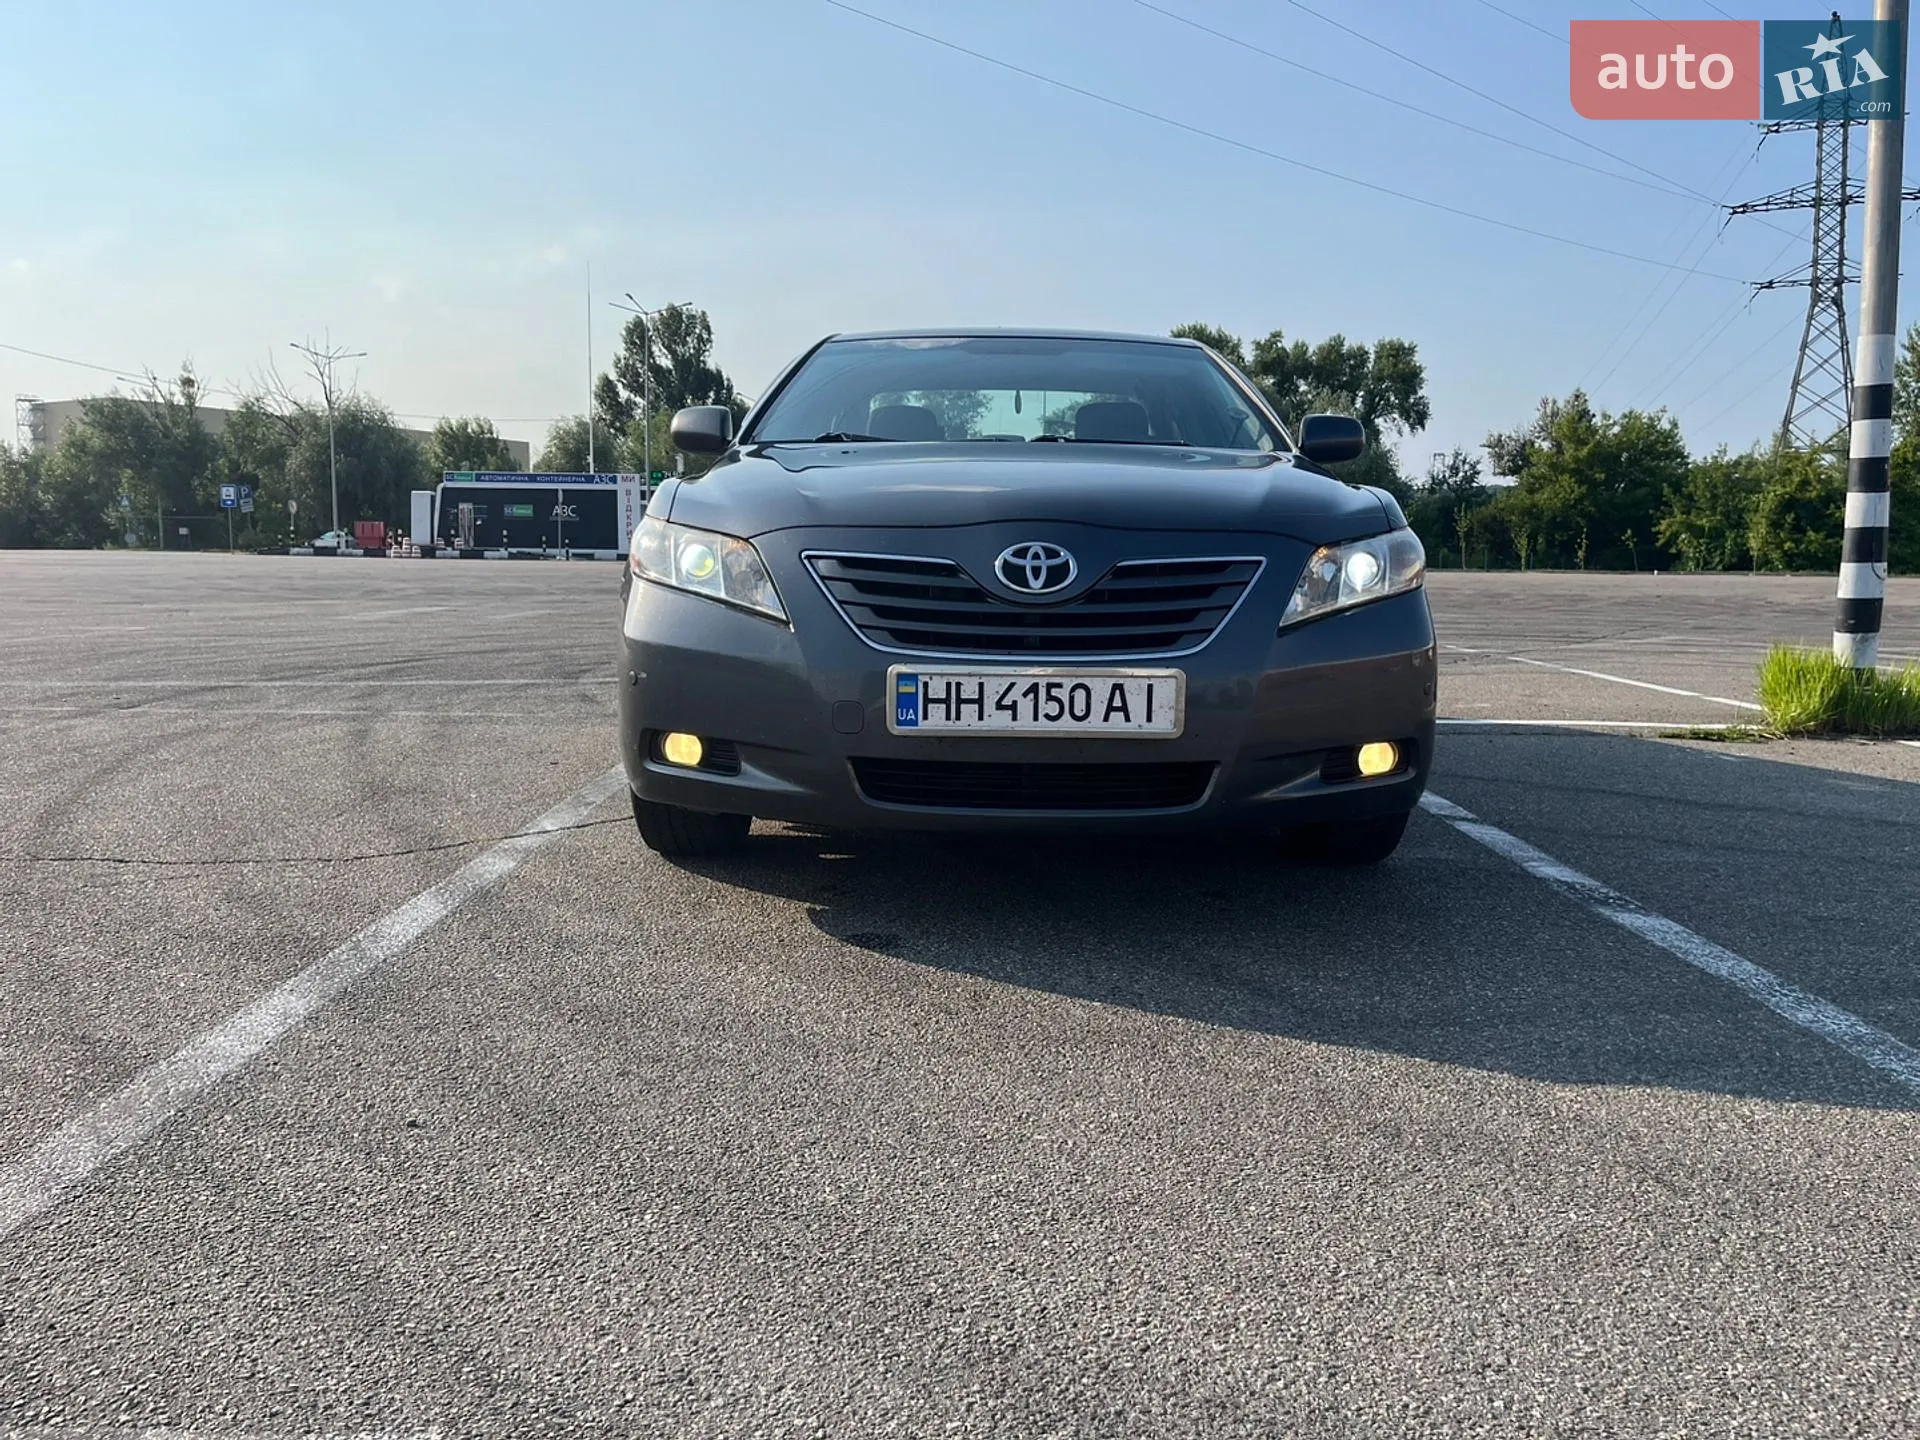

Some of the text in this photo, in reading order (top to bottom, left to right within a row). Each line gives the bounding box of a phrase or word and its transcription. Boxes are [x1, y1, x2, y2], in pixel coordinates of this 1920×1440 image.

[593, 474, 614, 484] АЗС
[551, 505, 577, 517] АЗС
[922, 680, 984, 721] HH
[995, 681, 1092, 723] 4150
[897, 708, 916, 721] UA
